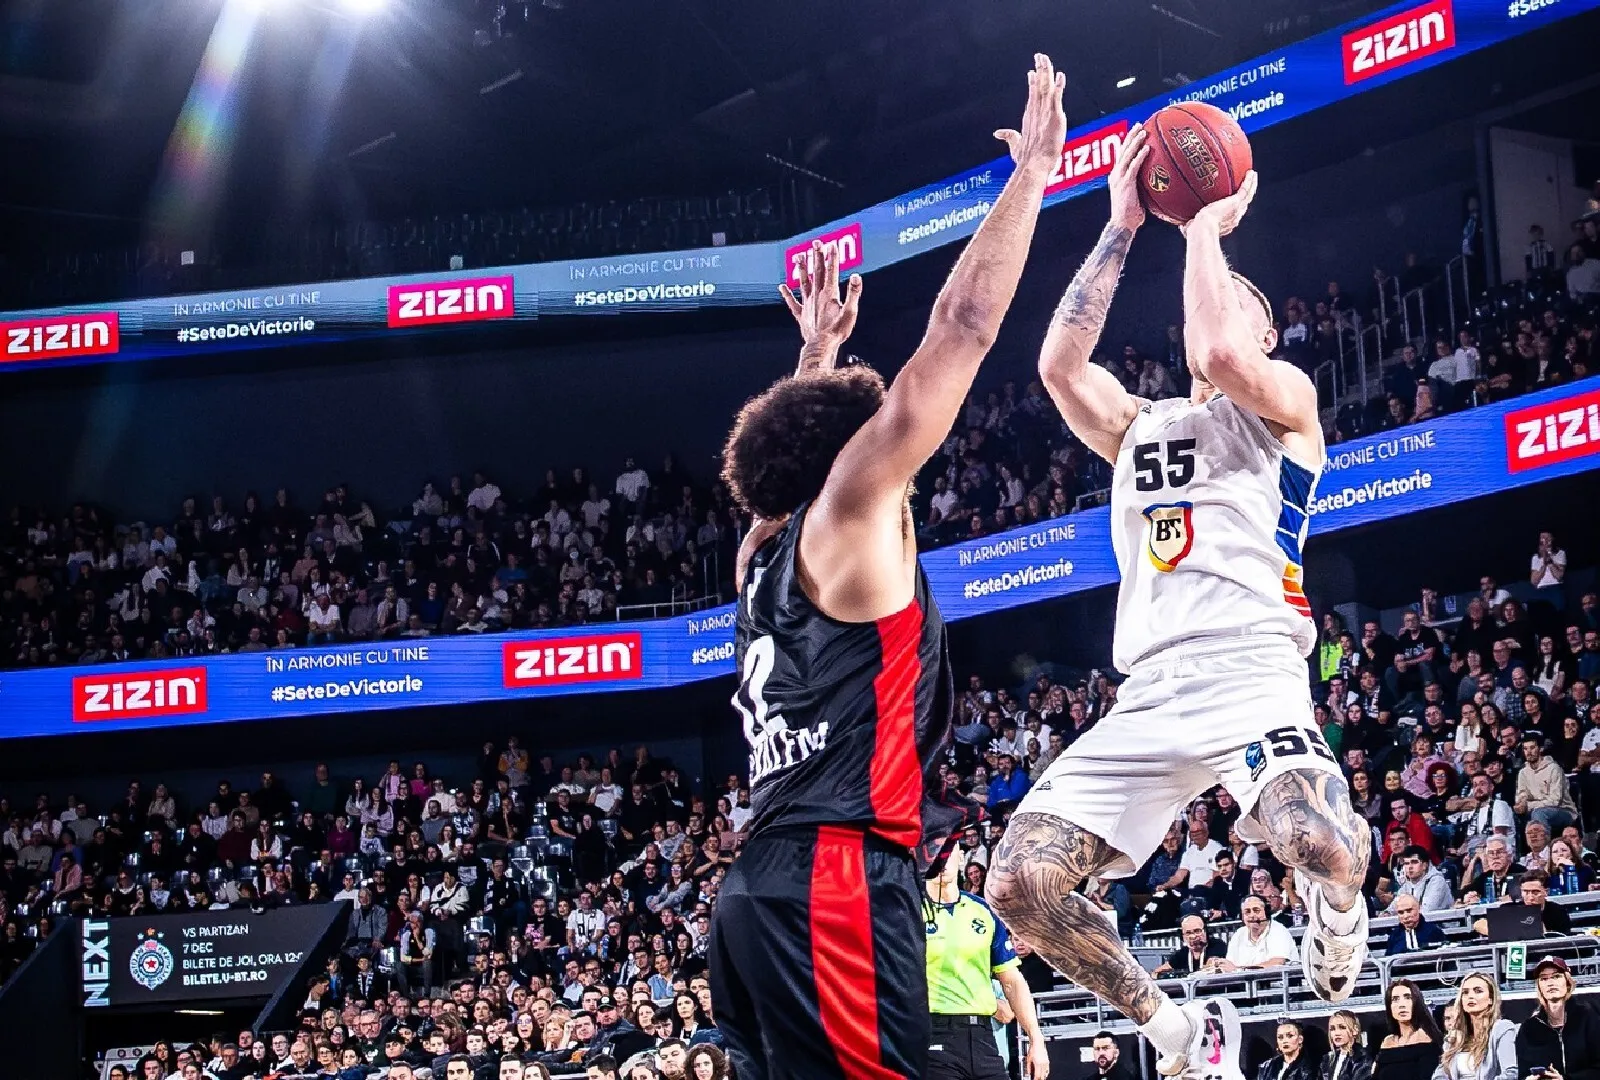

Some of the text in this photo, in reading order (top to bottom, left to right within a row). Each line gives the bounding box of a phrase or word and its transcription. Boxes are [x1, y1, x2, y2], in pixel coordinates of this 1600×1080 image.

[1240, 69, 1257, 86] CU
[1258, 57, 1286, 78] TINE
[1229, 91, 1284, 121] Victorie
[907, 187, 951, 213] ARMONIE
[953, 179, 968, 196] CU
[969, 170, 992, 189] TINE
[897, 201, 991, 245] #SeteDeVictorie
[589, 260, 659, 277] ARMONIE
[663, 259, 684, 272] CU
[688, 254, 721, 269] TINE
[192, 297, 261, 315] ARMONIE
[264, 295, 285, 309] CU
[288, 291, 321, 305] TINE
[575, 279, 716, 306] #SeteDeVictorie
[177, 316, 315, 342] #SeteDeVictorie
[1378, 440, 1399, 459] CU
[1400, 430, 1436, 453] TINE
[1133, 438, 1197, 492] 55
[973, 537, 1028, 563] ARMONIE
[1030, 532, 1047, 548] CU
[1048, 524, 1076, 543] TINE
[1156, 518, 1182, 542] BT
[964, 558, 1074, 599] #SeteDeVictorie
[288, 652, 362, 671] ARMONIE
[366, 650, 388, 664] CU
[391, 647, 429, 662] TINE
[271, 674, 423, 702] #SeteDeVictorie
[182, 924, 249, 938] VS PARTIZAN
[183, 942, 213, 954] 7 DEC
[83, 918, 109, 1007] NEXT
[183, 957, 216, 970] BILETE
[219, 956, 233, 968] DE
[258, 954, 283, 965] ORA
[183, 970, 268, 986] BILETE.U-BT.RO
